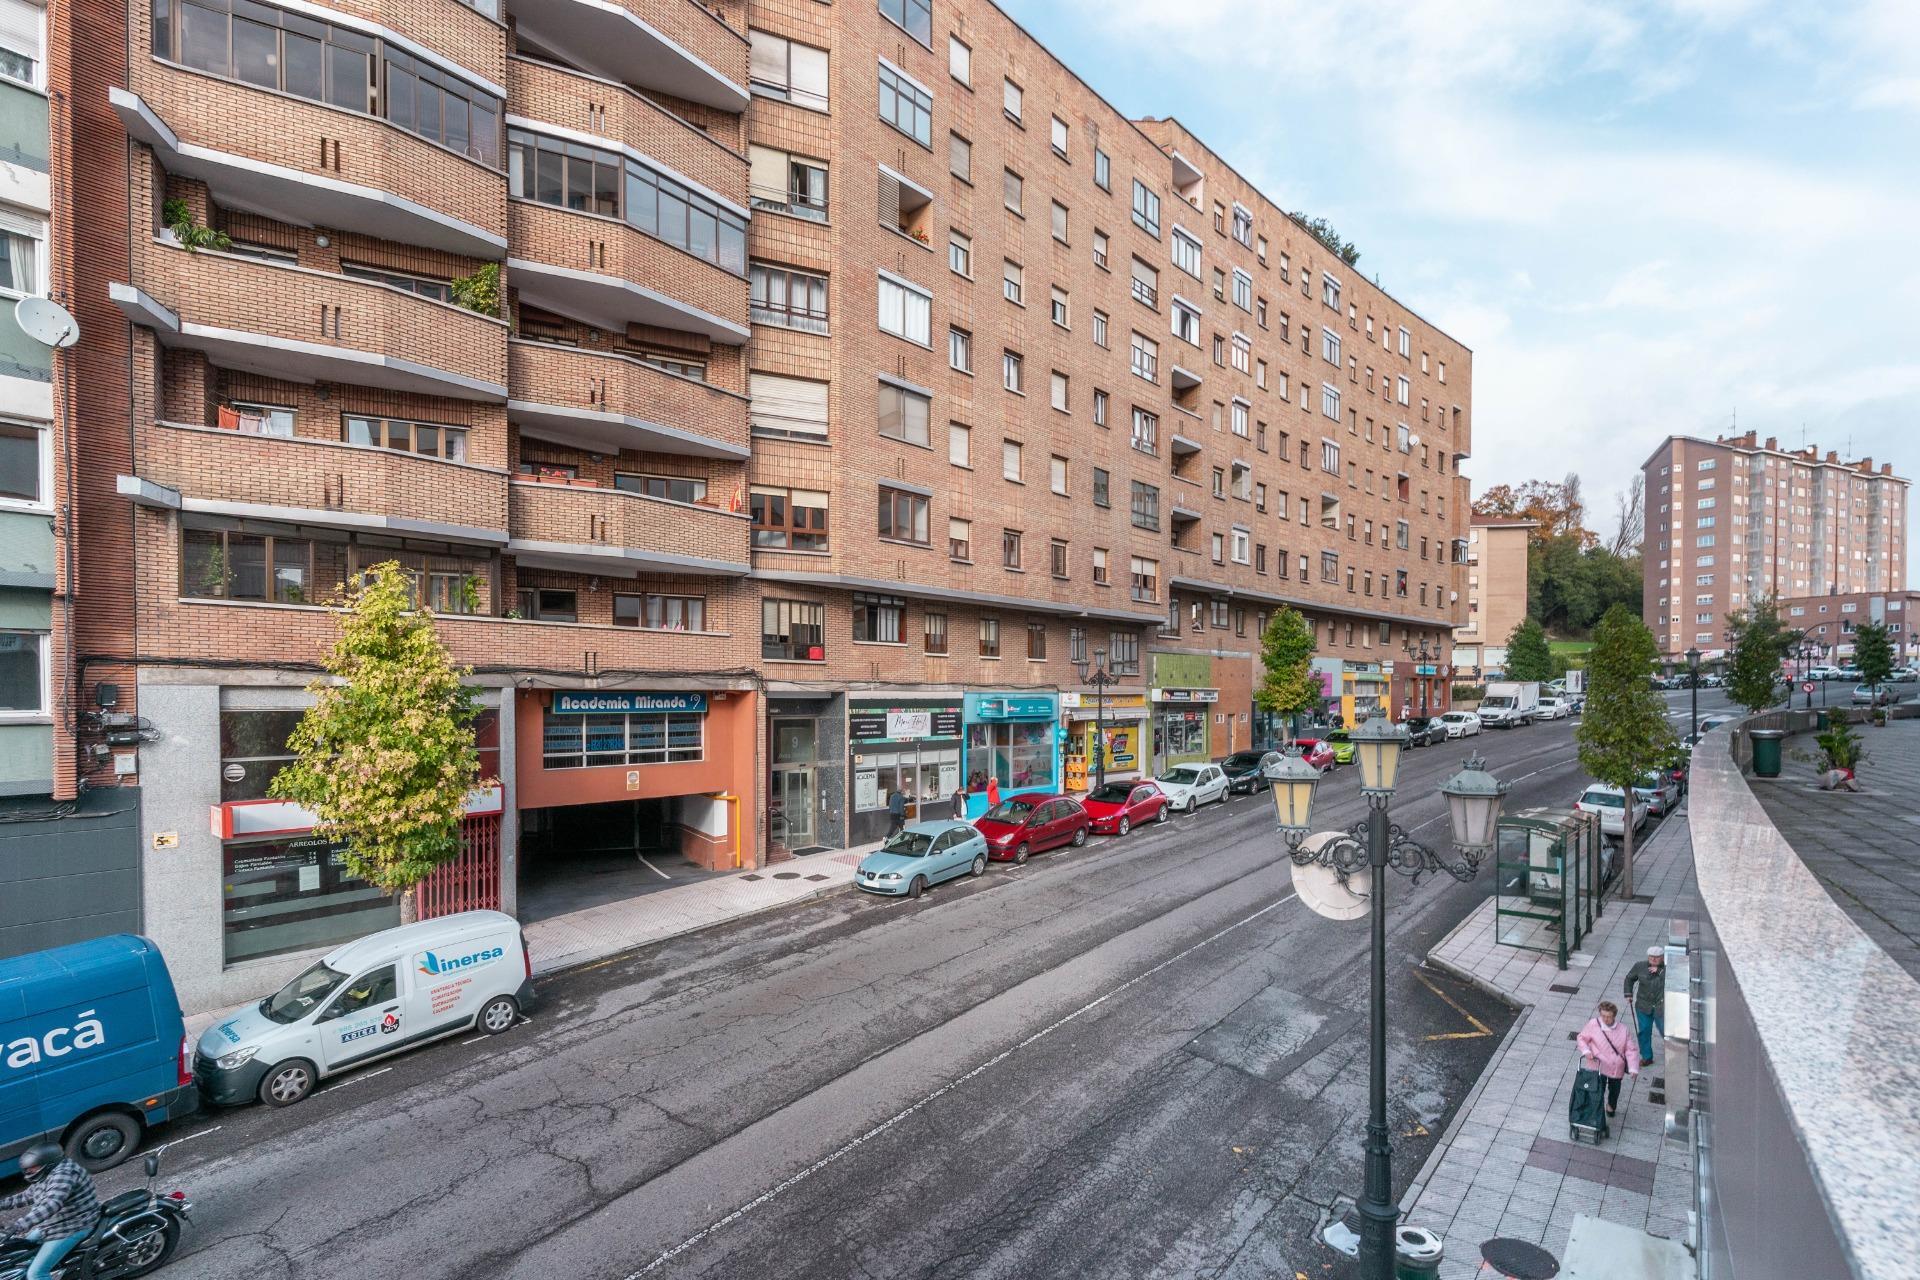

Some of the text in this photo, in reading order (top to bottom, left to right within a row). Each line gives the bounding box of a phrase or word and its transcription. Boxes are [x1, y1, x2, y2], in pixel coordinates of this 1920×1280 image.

[561, 695, 686, 710] Academia Miranda
[791, 736, 799, 748] 9
